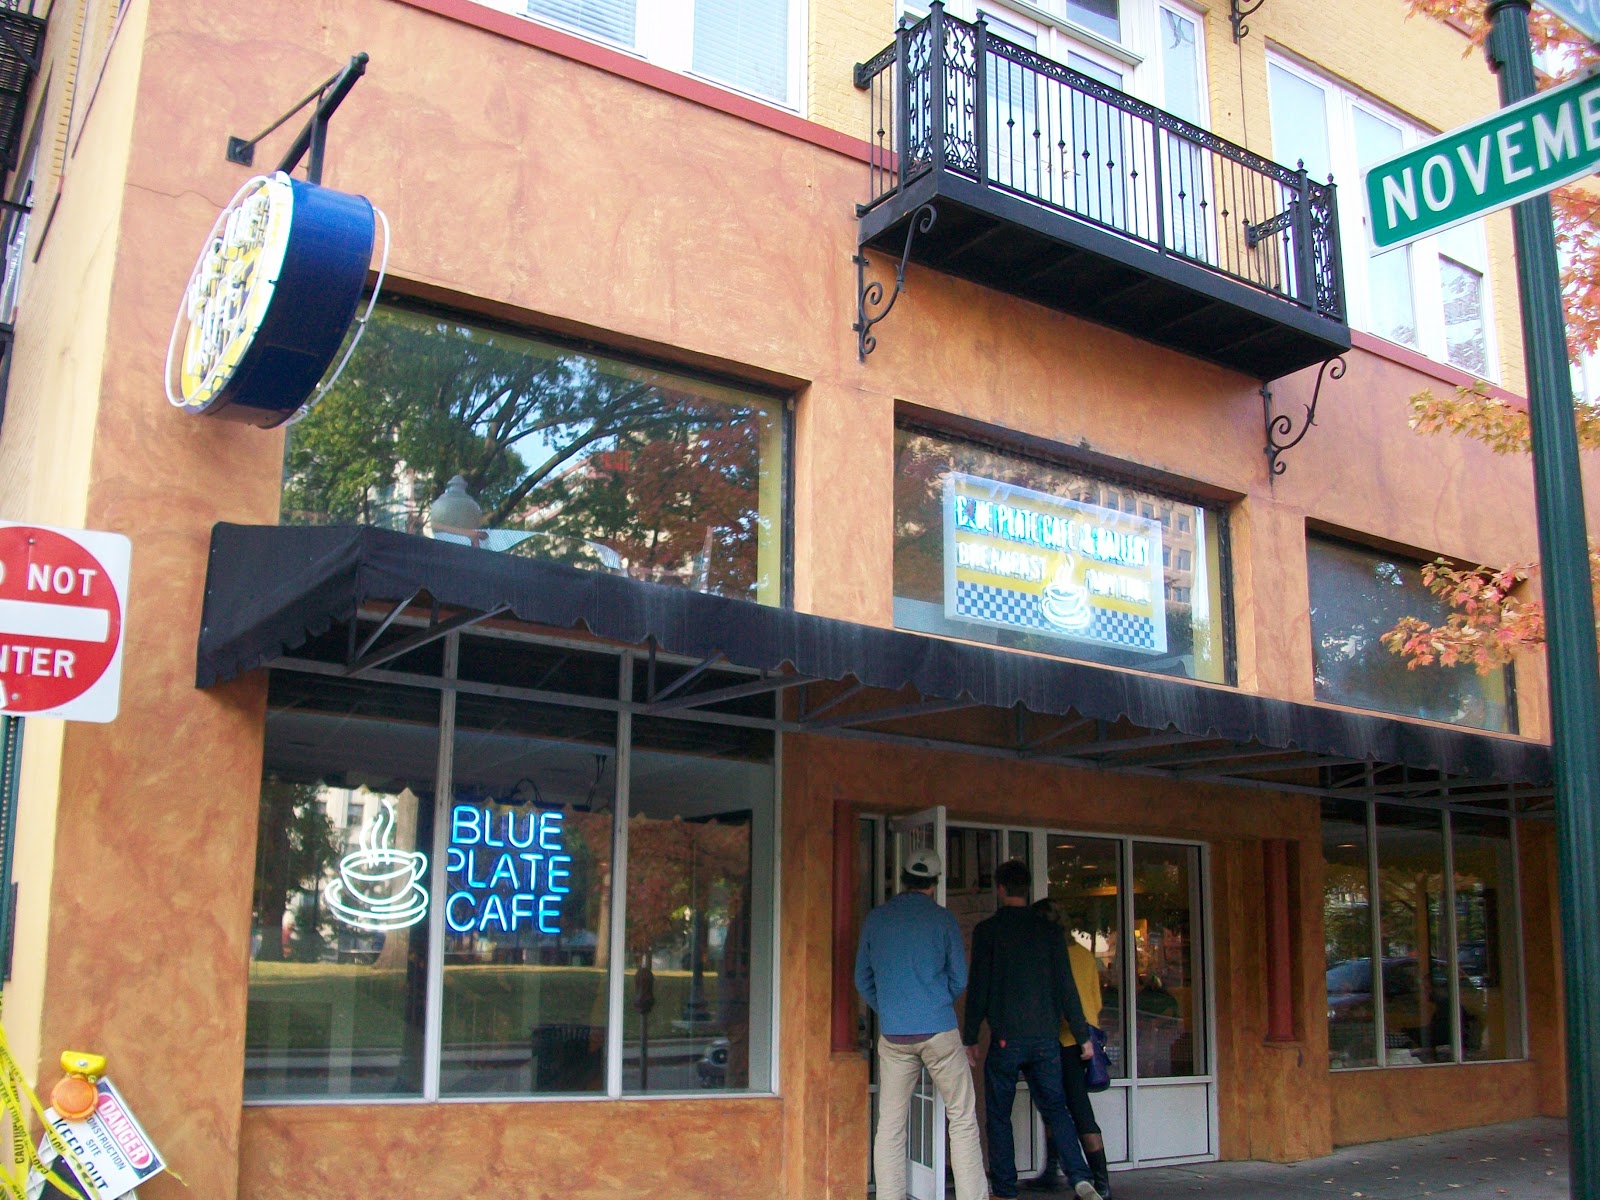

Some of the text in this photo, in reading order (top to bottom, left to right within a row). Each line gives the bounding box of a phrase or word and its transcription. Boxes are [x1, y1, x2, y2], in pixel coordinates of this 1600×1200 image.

[27, 562, 97, 597] NOT
[0, 645, 75, 679] TER
[452, 805, 563, 851] BLUE
[446, 848, 571, 893] PLATE
[445, 891, 562, 934] CAFE
[52, 1117, 84, 1156] KEEP
[85, 1161, 109, 1190] OUT
[85, 1138, 102, 1157] SITE
[86, 1117, 126, 1171] ONSTRUCTION
[99, 1099, 150, 1163] DANGER
